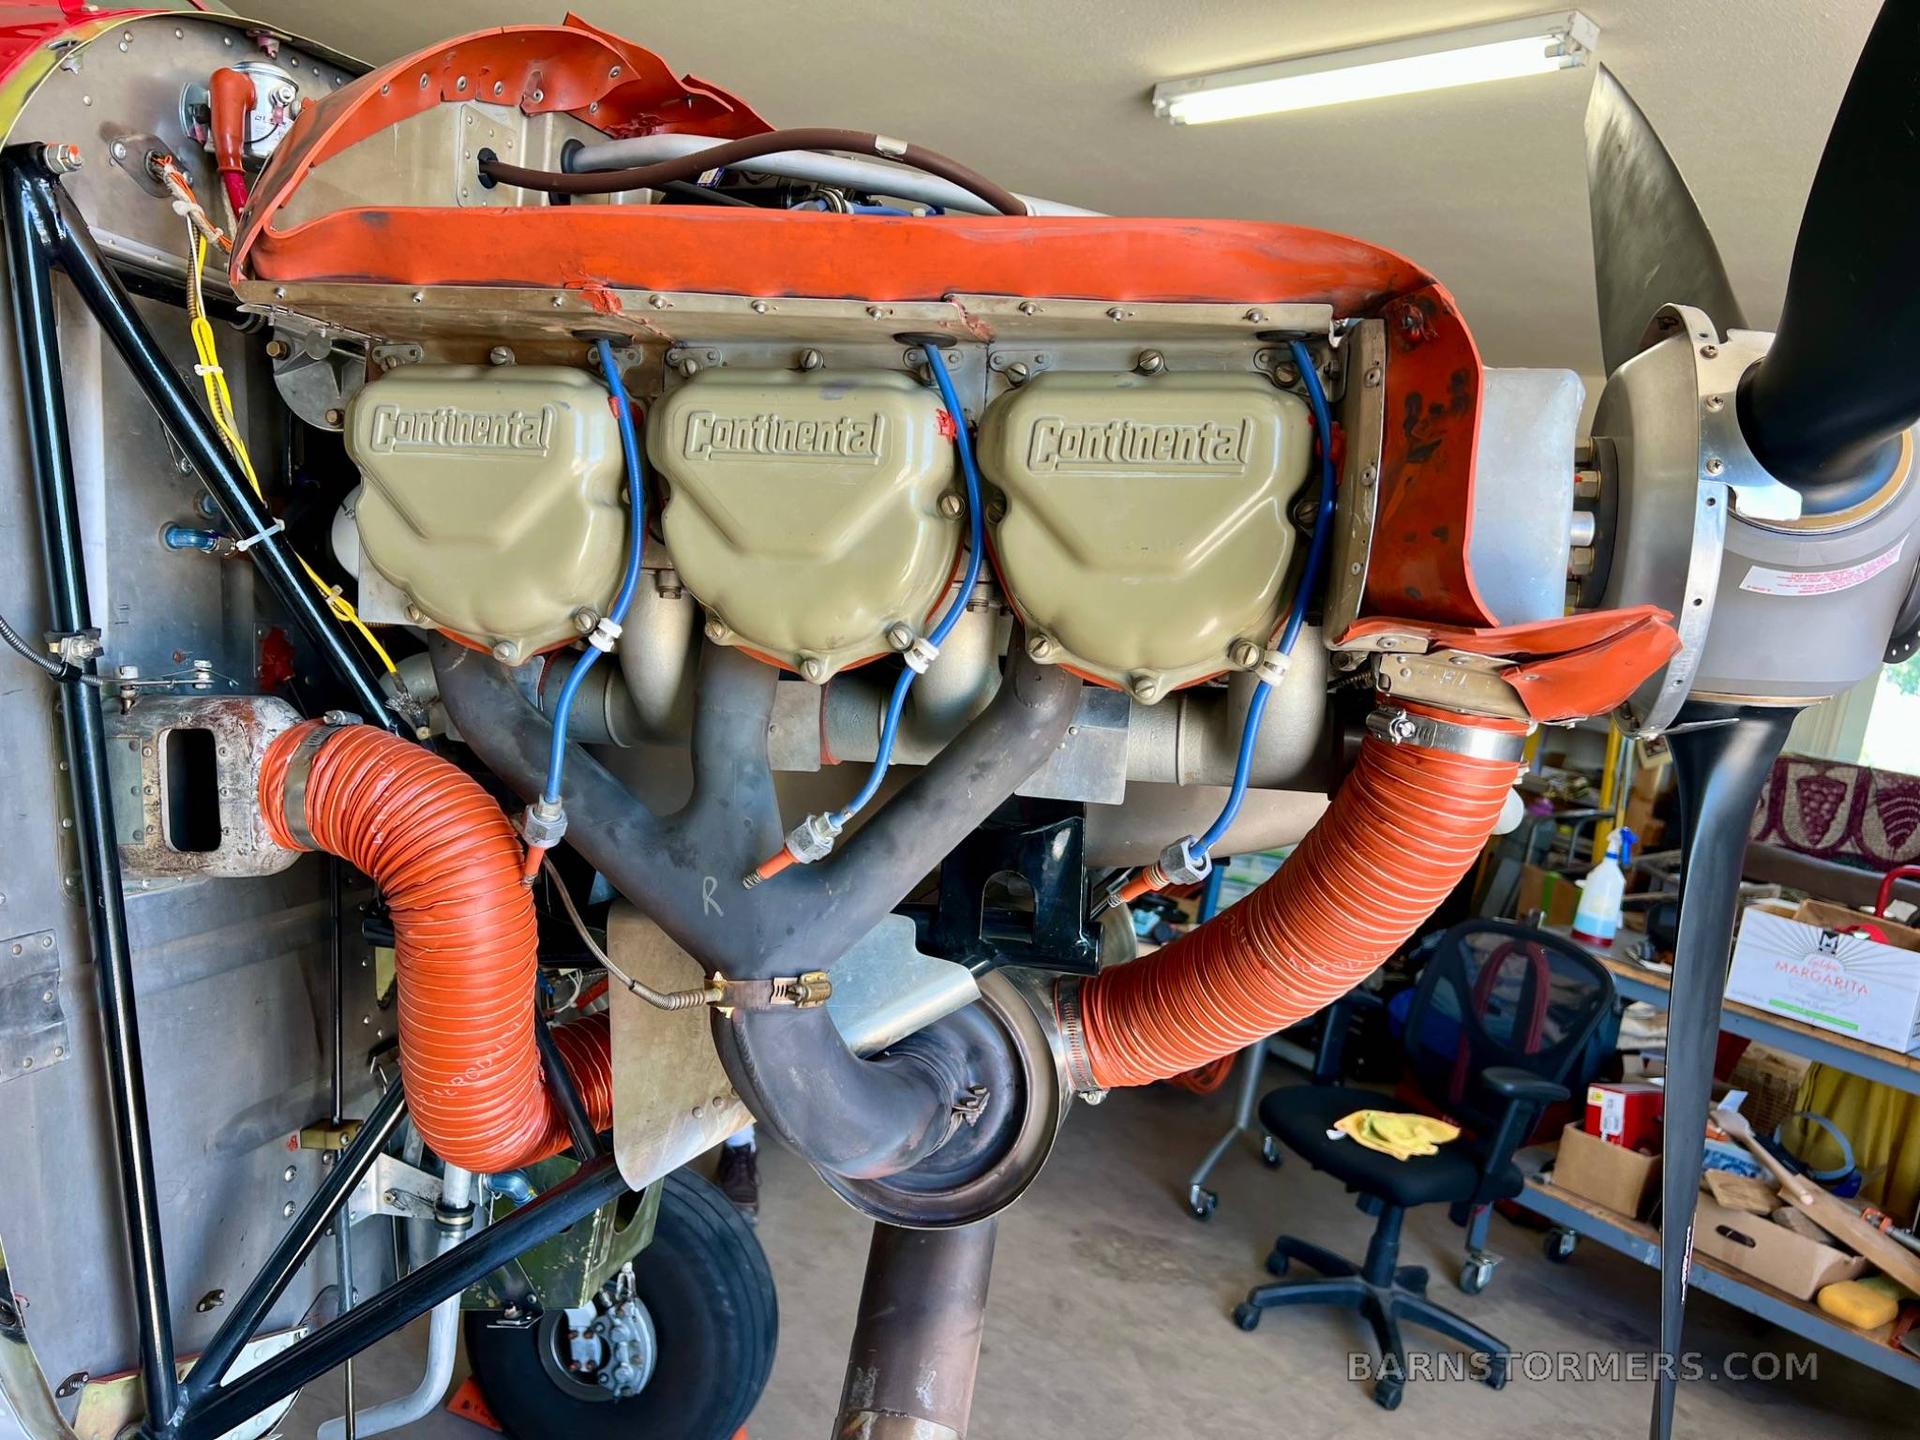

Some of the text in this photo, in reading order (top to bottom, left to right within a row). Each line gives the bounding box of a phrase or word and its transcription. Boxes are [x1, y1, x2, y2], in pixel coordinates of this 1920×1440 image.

[371, 404, 553, 457] Continental
[684, 411, 885, 464] Continental
[1027, 416, 1254, 472] Continental
[702, 875, 724, 917] R
[1775, 960, 1870, 995] MARGARITA
